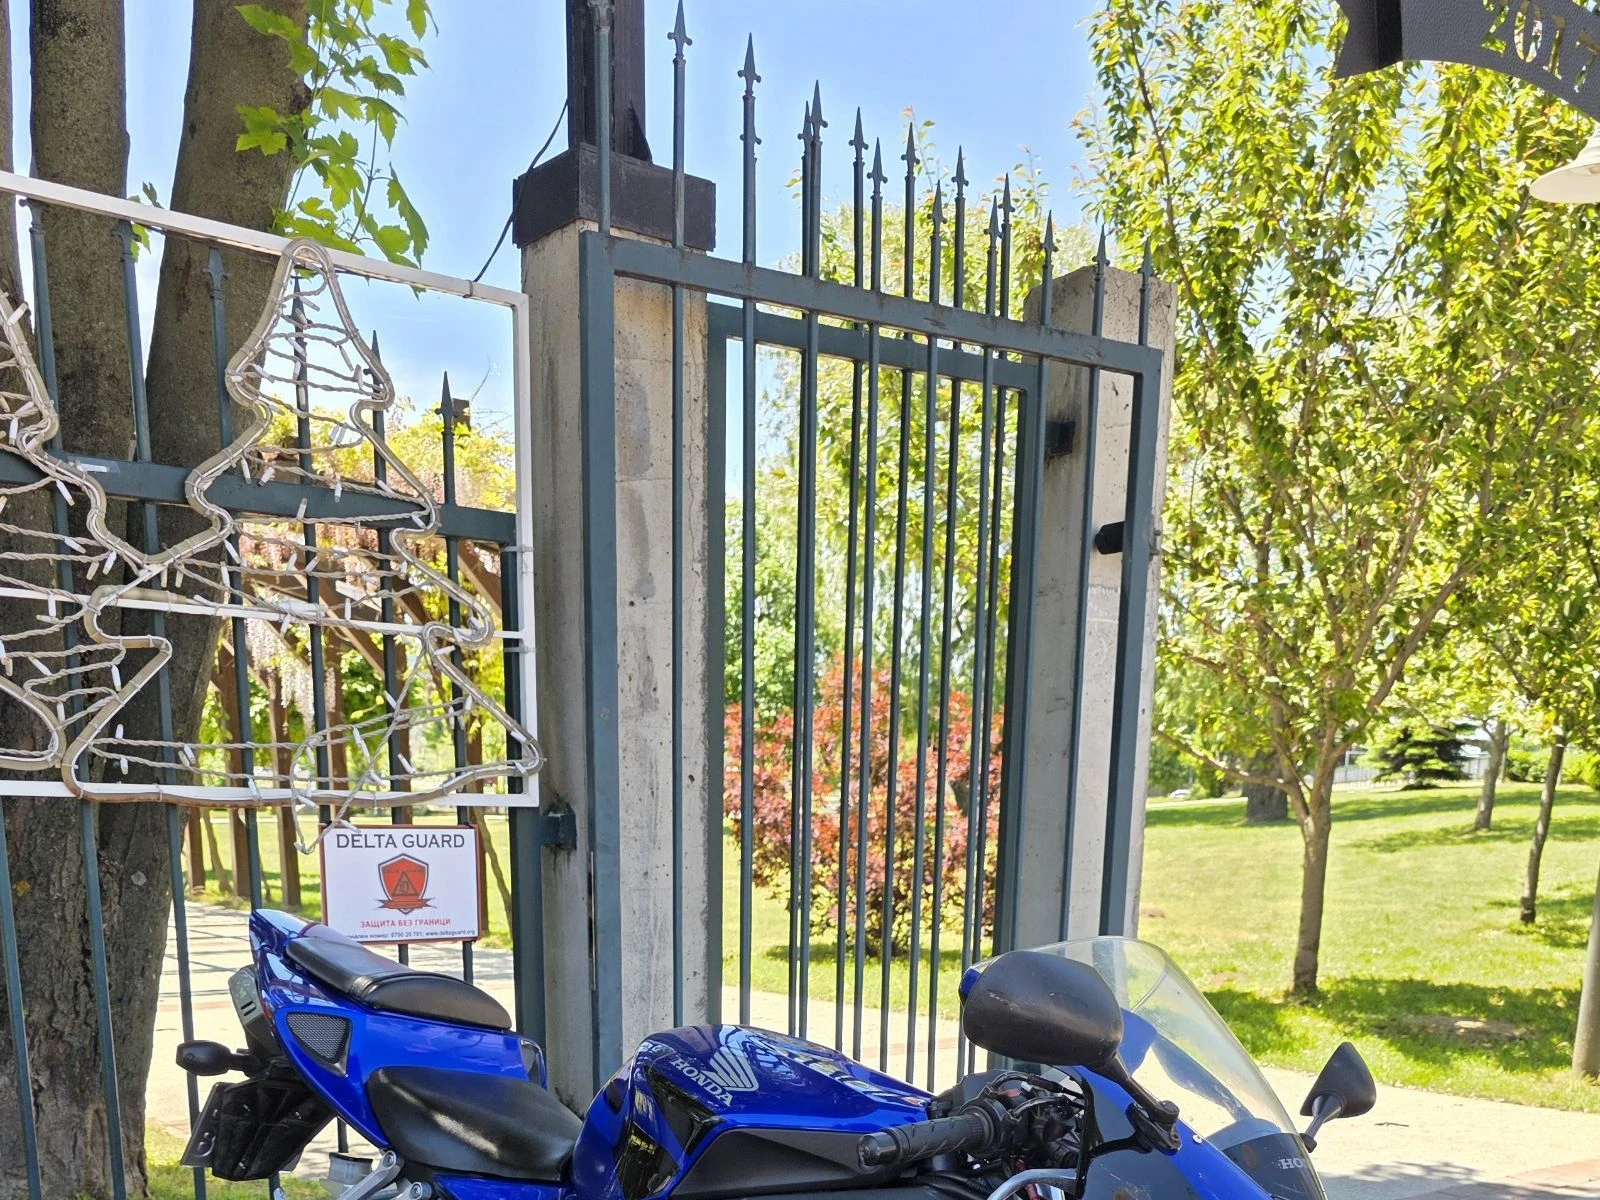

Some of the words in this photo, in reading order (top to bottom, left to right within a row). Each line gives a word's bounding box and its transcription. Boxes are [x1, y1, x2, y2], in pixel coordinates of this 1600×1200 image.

[336, 833, 397, 849] DELTA
[402, 833, 465, 849] GUARD
[360, 920, 396, 928] ЗАЩИТА
[398, 919, 413, 927] БЕЗ
[414, 918, 451, 926] ГРАНИЦИ
[670, 1056, 734, 1107] HONDA
[1279, 1158, 1307, 1169] HO
